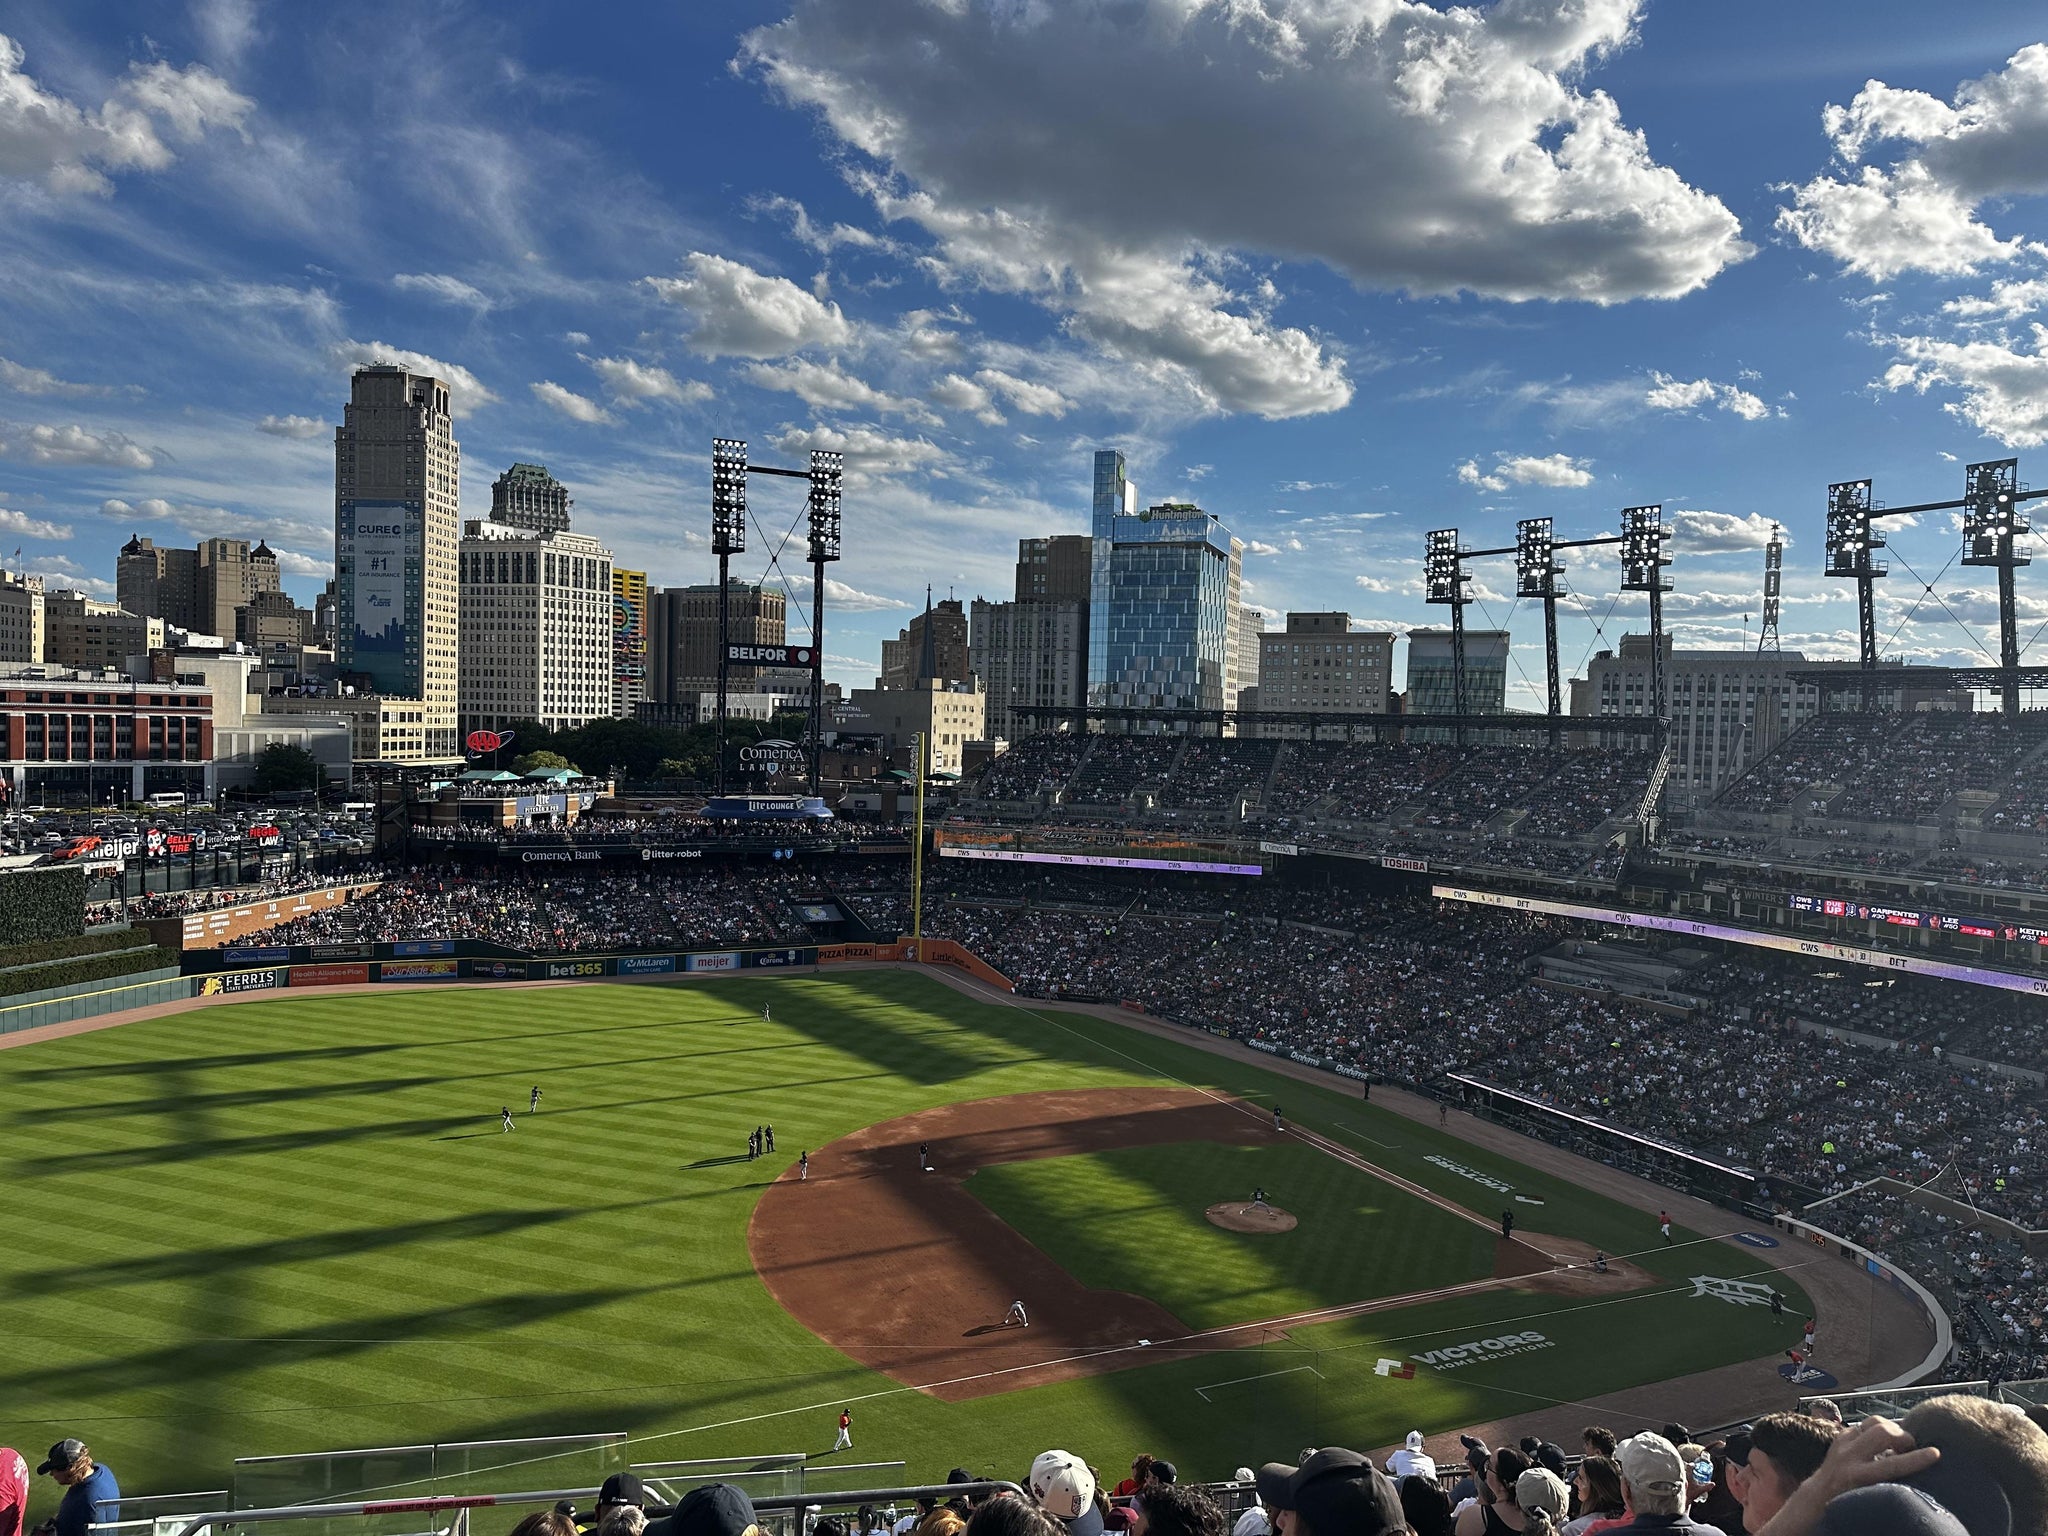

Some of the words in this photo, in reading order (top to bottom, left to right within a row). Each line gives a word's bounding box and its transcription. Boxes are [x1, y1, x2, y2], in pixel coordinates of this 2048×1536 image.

[1152, 510, 1204, 522] Huntington
[358, 525, 391, 534] CURE
[371, 557, 387, 570] #1
[729, 646, 787, 661] BELFOR
[470, 732, 497, 749] AAA
[740, 764, 806, 772] LANDING
[748, 801, 766, 812] Lite
[767, 802, 794, 810] LOUNGE
[249, 828, 279, 838] FIEGER
[166, 835, 193, 845] BELLE
[259, 836, 278, 846] LAW
[170, 844, 189, 853] TIRE
[575, 850, 601, 860] Bank
[1383, 858, 1426, 871] TOSHIBA
[326, 891, 335, 900] 42
[1744, 891, 1784, 904] WINTER'S
[269, 903, 277, 912] 10
[1871, 907, 1919, 919] CARPENTER
[1615, 914, 1631, 923] CWS
[1692, 924, 1706, 934] DET
[2019, 928, 2048, 937] KEITH
[845, 949, 872, 957] PIZZA!
[1801, 943, 1819, 953] CWS
[819, 951, 844, 959] PIZZA!
[636, 959, 669, 967] McLaren
[698, 956, 730, 968] meijer
[760, 957, 783, 965] Corona
[1889, 957, 1907, 968] DET
[387, 965, 428, 977] Surfside
[551, 963, 602, 977] bet365
[226, 972, 274, 986] FERRIS
[226, 984, 241, 992] STATE
[243, 982, 273, 990] UNIVERSITY
[1409, 1331, 1546, 1365] VICTORS
[1434, 1358, 1477, 1371] HOME
[1478, 1341, 1556, 1362] SOLUTIONS
